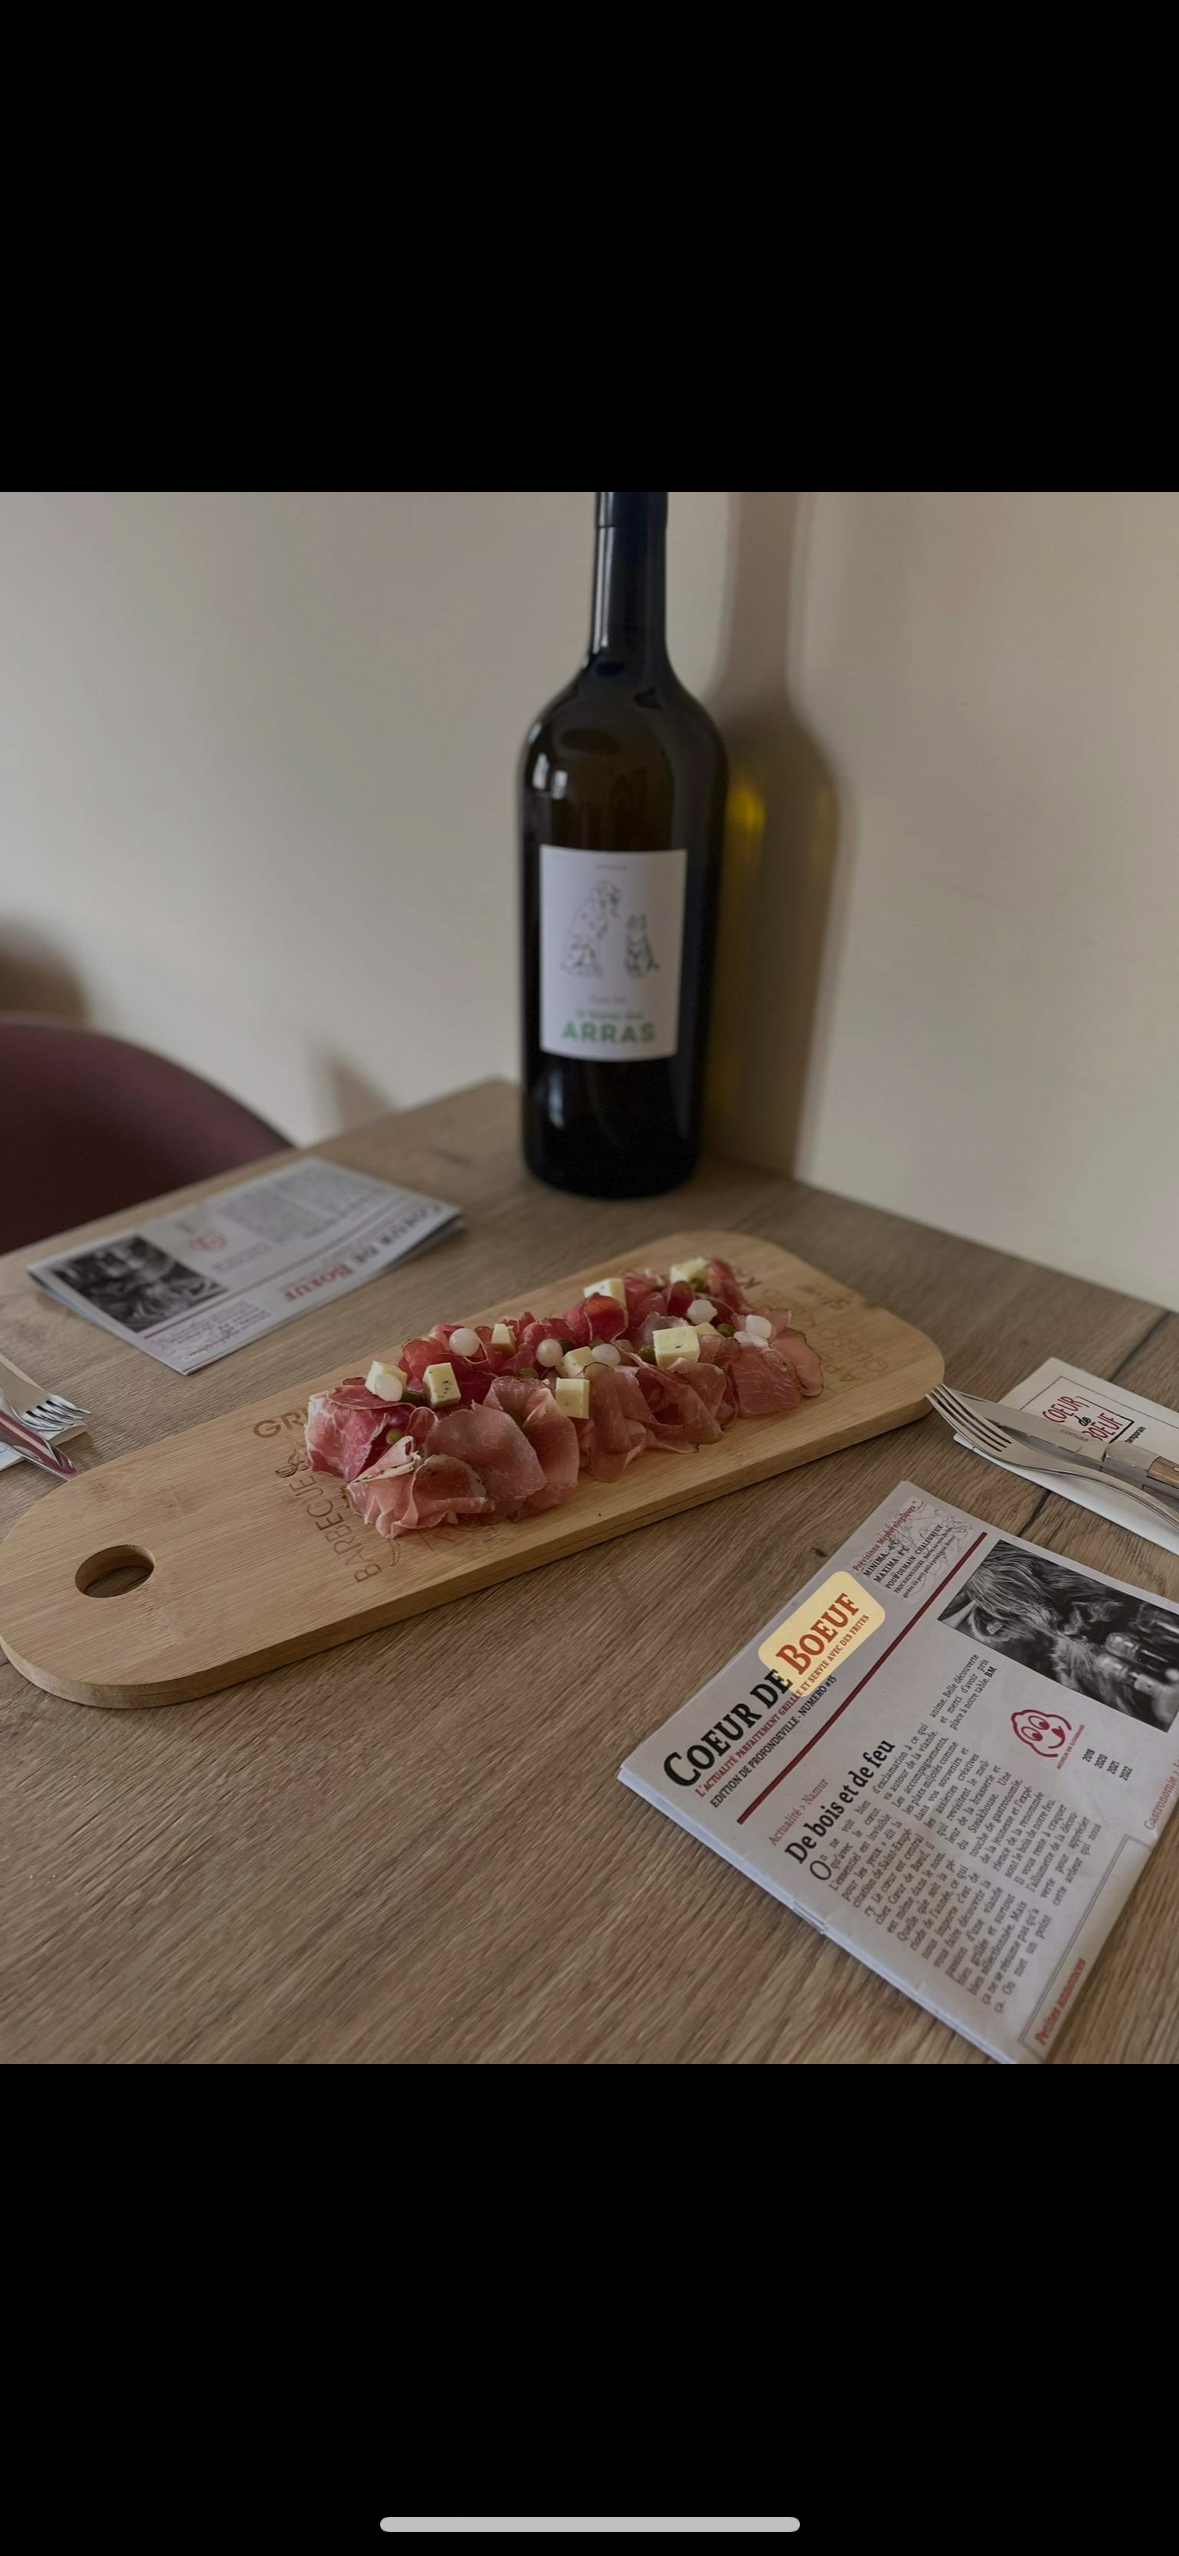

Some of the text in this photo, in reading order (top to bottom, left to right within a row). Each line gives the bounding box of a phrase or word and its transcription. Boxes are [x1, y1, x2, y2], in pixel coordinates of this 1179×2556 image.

[562, 1020, 656, 1044] ARRAS
[281, 1260, 354, 1305] BOEUF
[349, 1242, 380, 1268] DE
[1042, 1396, 1090, 1423] COEUR
[289, 1475, 383, 1584] BARBECUE
[852, 1543, 879, 1570] Prévisions
[863, 1553, 887, 1576] MINIMA
[874, 1557, 898, 1582] MAXIMA
[898, 1545, 909, 1555] 8°C
[885, 1575, 899, 1588] POUR
[897, 1555, 915, 1574] DEMAIN
[664, 1593, 858, 1785] COEUR DE BOEUF
[695, 1755, 738, 1796] L'ACTUALITÉ
[735, 1713, 779, 1758] PARFAITEMENT
[800, 1680, 810, 1691] ET
[807, 1660, 829, 1682] SERVIE
[827, 1644, 842, 1661] AVEC
[839, 1633, 852, 1646] DES
[849, 1614, 868, 1634] FRITES
[929, 1654, 978, 1717] anime. Belle découverte
[946, 1695, 962, 1713] merci
[960, 1673, 978, 1693] d'avoir
[976, 1659, 988, 1672] pris
[949, 1712, 964, 1730] place
[964, 1692, 978, 1709] notre
[974, 1678, 989, 1693] table.
[984, 1666, 996, 1677] BM
[710, 1774, 741, 1807] EDITION
[738, 1765, 751, 1777] DE
[748, 1716, 799, 1767] PROFONDEVILLE
[798, 1685, 826, 1715] NUMERO
[825, 1674, 836, 1686] #15
[871, 1751, 907, 1794] d'exclamation
[910, 1736, 919, 1744] ce
[917, 1722, 928, 1735] qui
[883, 1731, 937, 1800] va autour de la viande.
[891, 1737, 948, 1808] Les accompagnements,
[1082, 1748, 1094, 1762] 2019
[1094, 1753, 1107, 1768] 2020
[1106, 1760, 1119, 1774] 2021
[1119, 1765, 1132, 1780] 2022
[768, 1808, 801, 1845] Actualité
[801, 1778, 828, 1804] Namur
[784, 1740, 894, 1863] De bois et de feu
[901, 1741, 958, 1814] les plats mijotés comme
[913, 1747, 968, 1821] dans vos souvenirs et
[923, 1753, 979, 1828] les assiettes créatives
[936, 1760, 989, 1836] qui revisitent le meil-
[944, 1765, 1001, 1843] leur de la brasserie et
[956, 1771, 1011, 1850] du Steakhouse. Une
[1144, 1776, 1176, 1829] Gastronomie
[829, 1838, 839, 1848] ne
[841, 1818, 854, 1832] voit
[854, 1800, 870, 1814] bien
[830, 1842, 852, 1869] qu'avec
[851, 1830, 862, 1838] le
[969, 1832, 988, 1856] touche
[984, 1822, 995, 1832] de
[979, 1786, 1032, 1864] de la jeunesse et l'expé-
[992, 1791, 1044, 1871] rience de la renommée
[1004, 1799, 1055, 1878] sont le bois de notre feu.
[1014, 1875, 1024, 1885] Il
[1021, 1857, 1035, 1874] vous
[1032, 1838, 1046, 1856] reste
[1048, 1804, 1066, 1830] craquer
[1025, 1812, 1077, 1891] l'allumette de la décou-
[1040, 1816, 1089, 1897] verte pour apprécier
[1052, 1823, 1101, 1905] cette ardeur qui nous
[1035, 1958, 1085, 2045] Petites annonces
